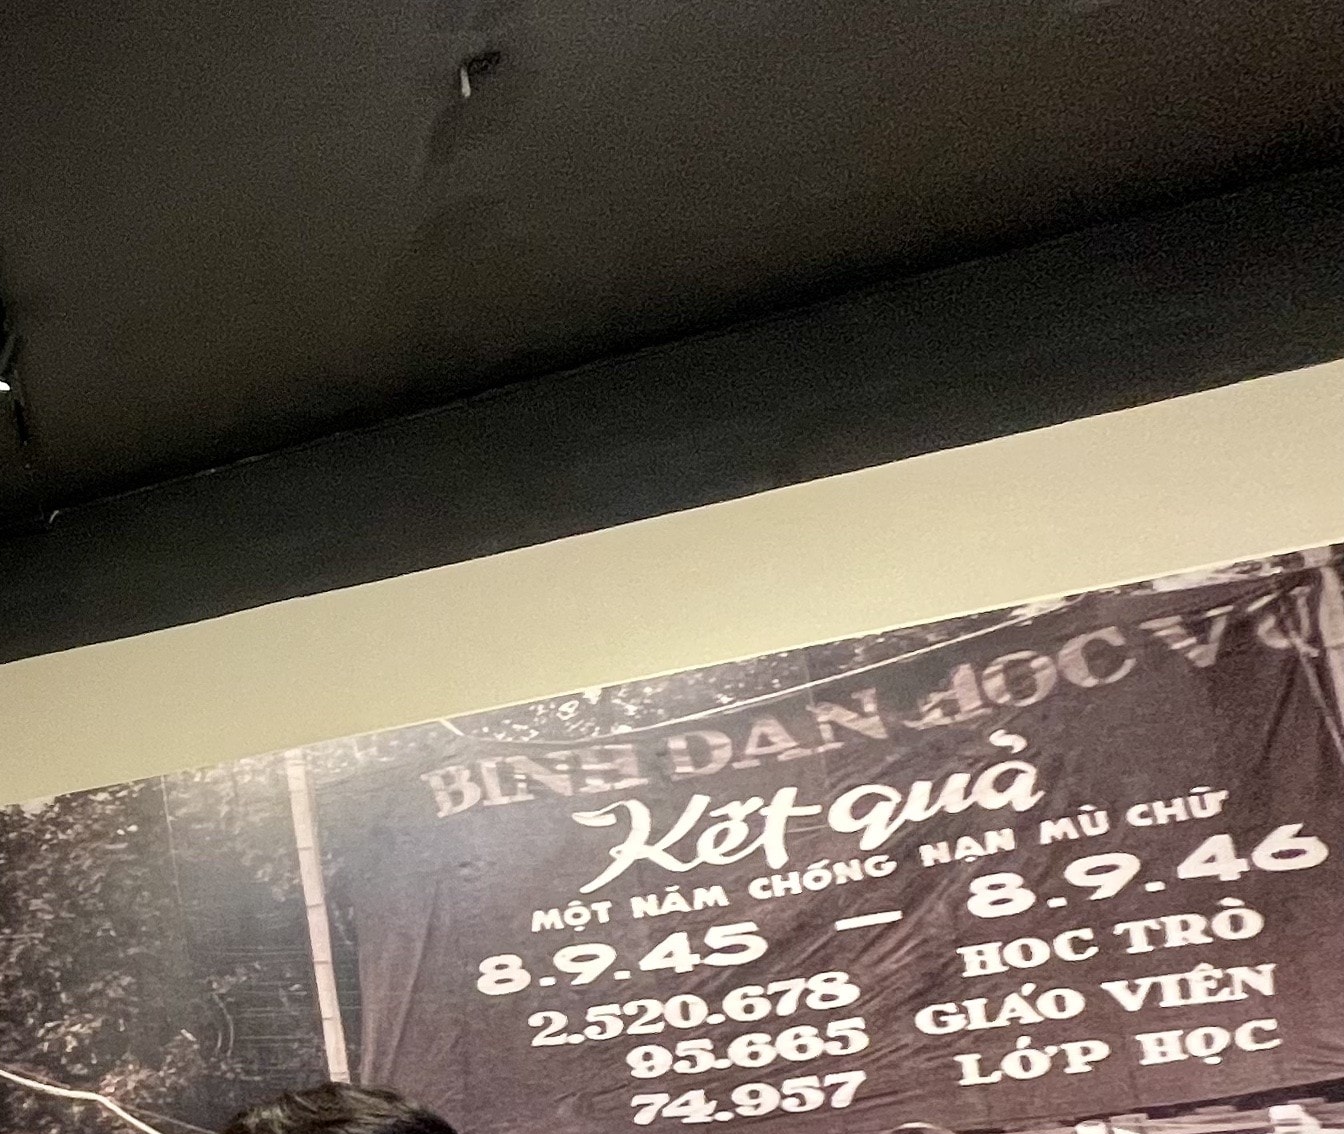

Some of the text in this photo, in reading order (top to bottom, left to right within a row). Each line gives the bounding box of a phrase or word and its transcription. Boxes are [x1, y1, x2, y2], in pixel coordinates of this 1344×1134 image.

[531, 786, 1229, 932] MỘT NĂM CHỐNG NẠN MÙ CHỮ
[572, 729, 1047, 893] Kết quả
[477, 822, 1330, 995] 8.9.45 8.9.46
[528, 971, 861, 1047] 2.520.678
[1113, 897, 1265, 954] TRÒ
[626, 962, 1277, 1079] 95.665 GIÁO VIÊN
[630, 1019, 1283, 1126] 74.957 LỚP HỌC
